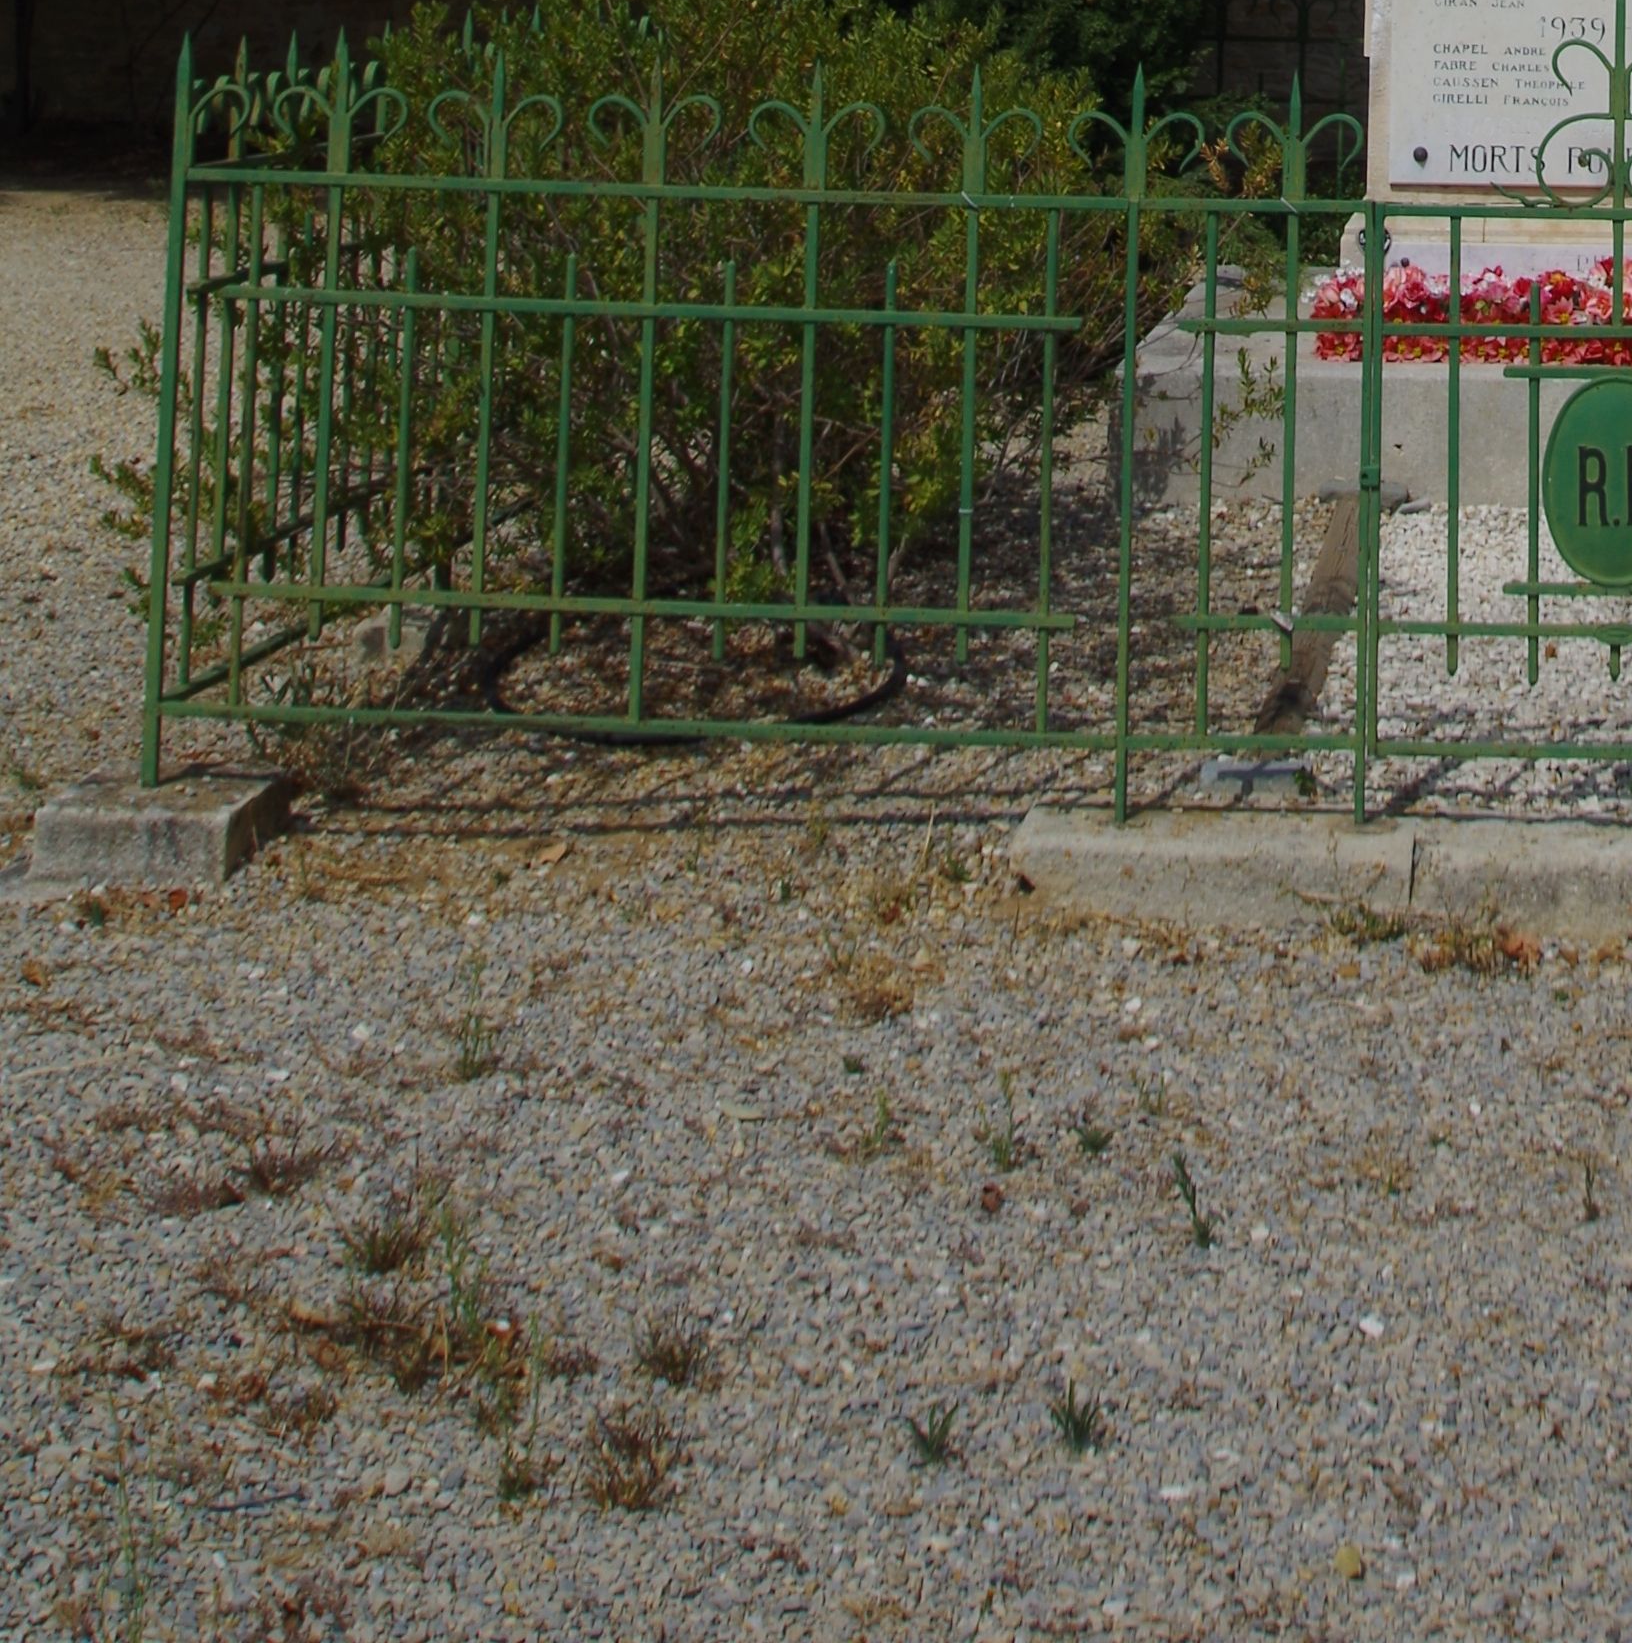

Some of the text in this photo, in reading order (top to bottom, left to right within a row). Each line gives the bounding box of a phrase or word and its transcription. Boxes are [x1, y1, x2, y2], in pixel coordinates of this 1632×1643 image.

[1538, 17, 1606, 44] 1939
[1433, 44, 1488, 55] CHAPEL
[1434, 60, 1550, 72] FABRE CHARLES
[1515, 79, 1586, 90] THEOPHLE
[1504, 95, 1569, 107] FRANÇOIS
[1449, 144, 1545, 173] MORTS
